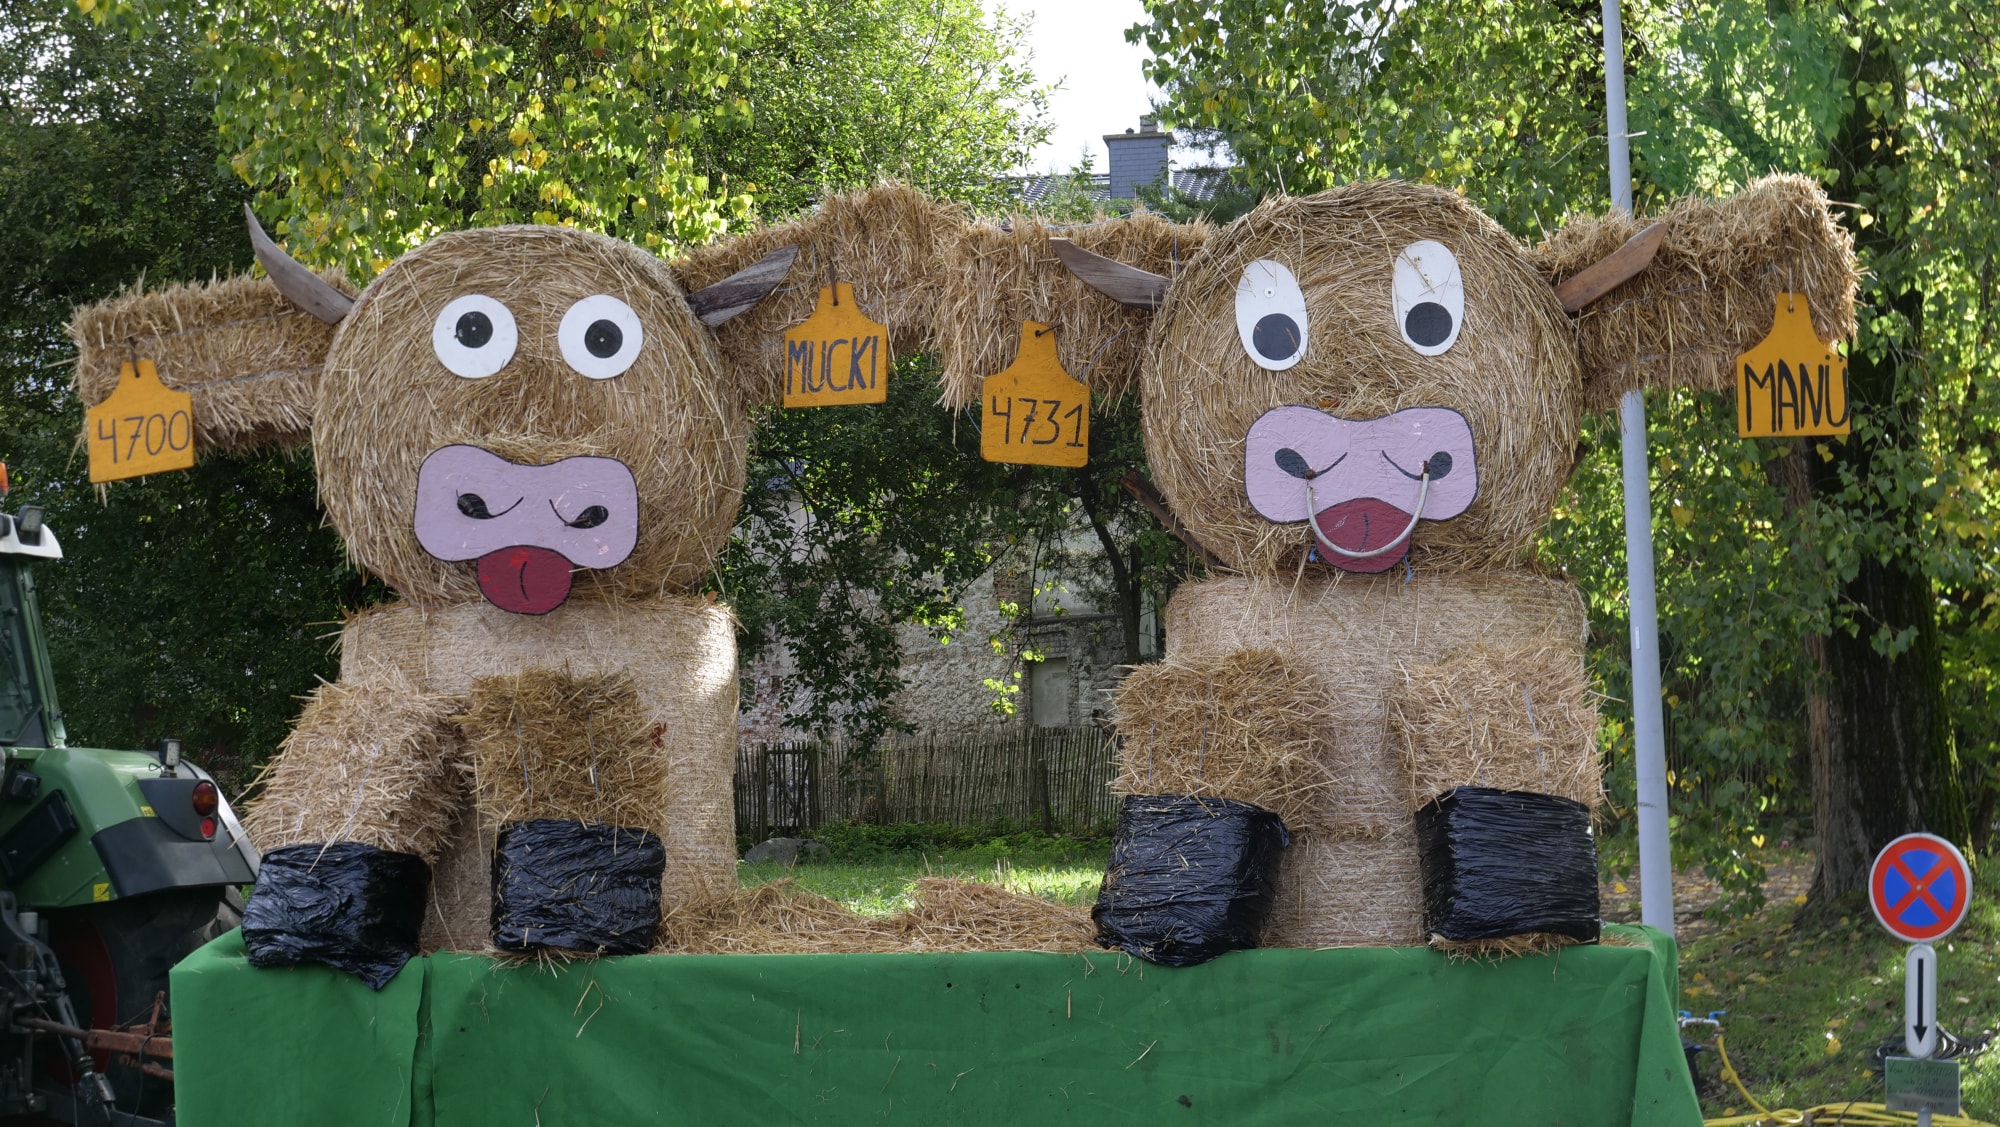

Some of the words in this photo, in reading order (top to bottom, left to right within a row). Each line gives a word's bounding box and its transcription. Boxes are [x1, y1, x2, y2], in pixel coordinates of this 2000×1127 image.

[786, 335, 879, 396] MUCKI
[1743, 354, 1850, 433] MANÜ
[98, 409, 191, 465] 4700
[991, 395, 1085, 447] 4731
